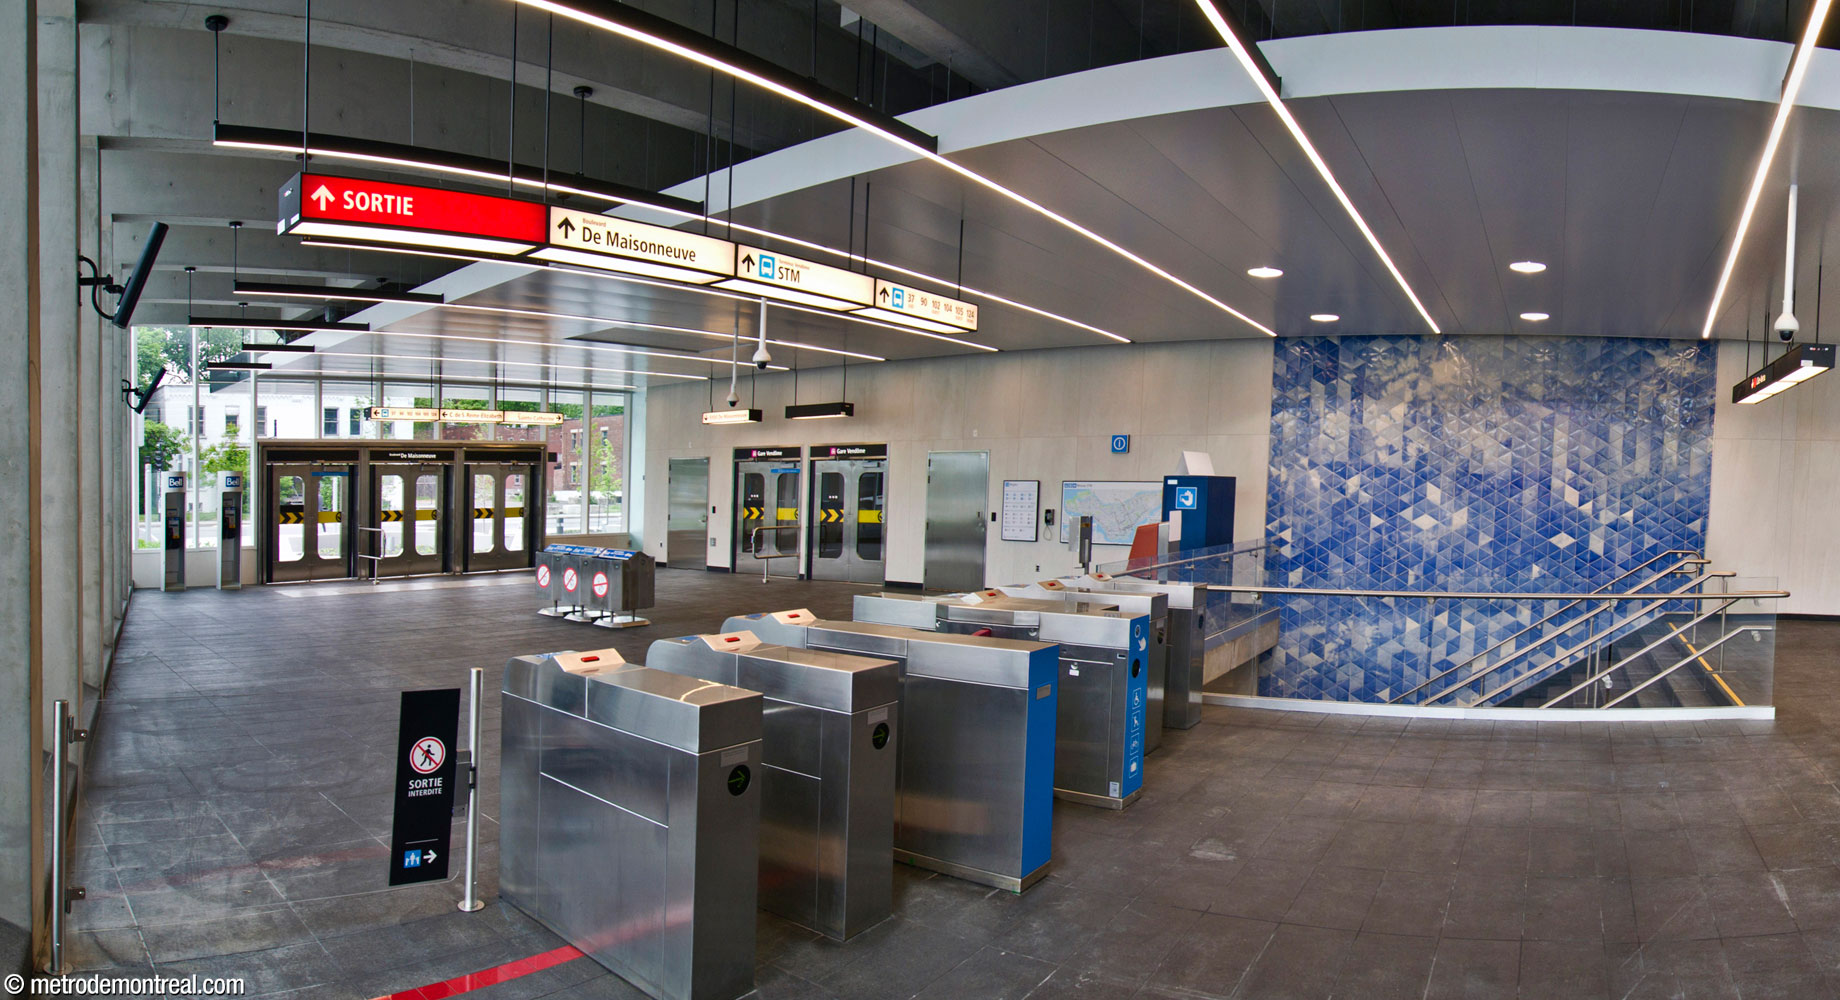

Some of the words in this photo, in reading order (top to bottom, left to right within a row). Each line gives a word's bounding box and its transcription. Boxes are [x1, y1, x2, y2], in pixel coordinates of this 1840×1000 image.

[343, 190, 414, 216] SORTIE
[582, 227, 602, 245] De
[606, 230, 696, 262] Maisonneuve
[778, 266, 800, 283] STM
[920, 297, 928, 307] 90
[169, 477, 183, 487] Bell
[226, 477, 240, 486] Bell
[408, 777, 443, 790] SORTIE
[408, 788, 443, 798] INTERDITE
